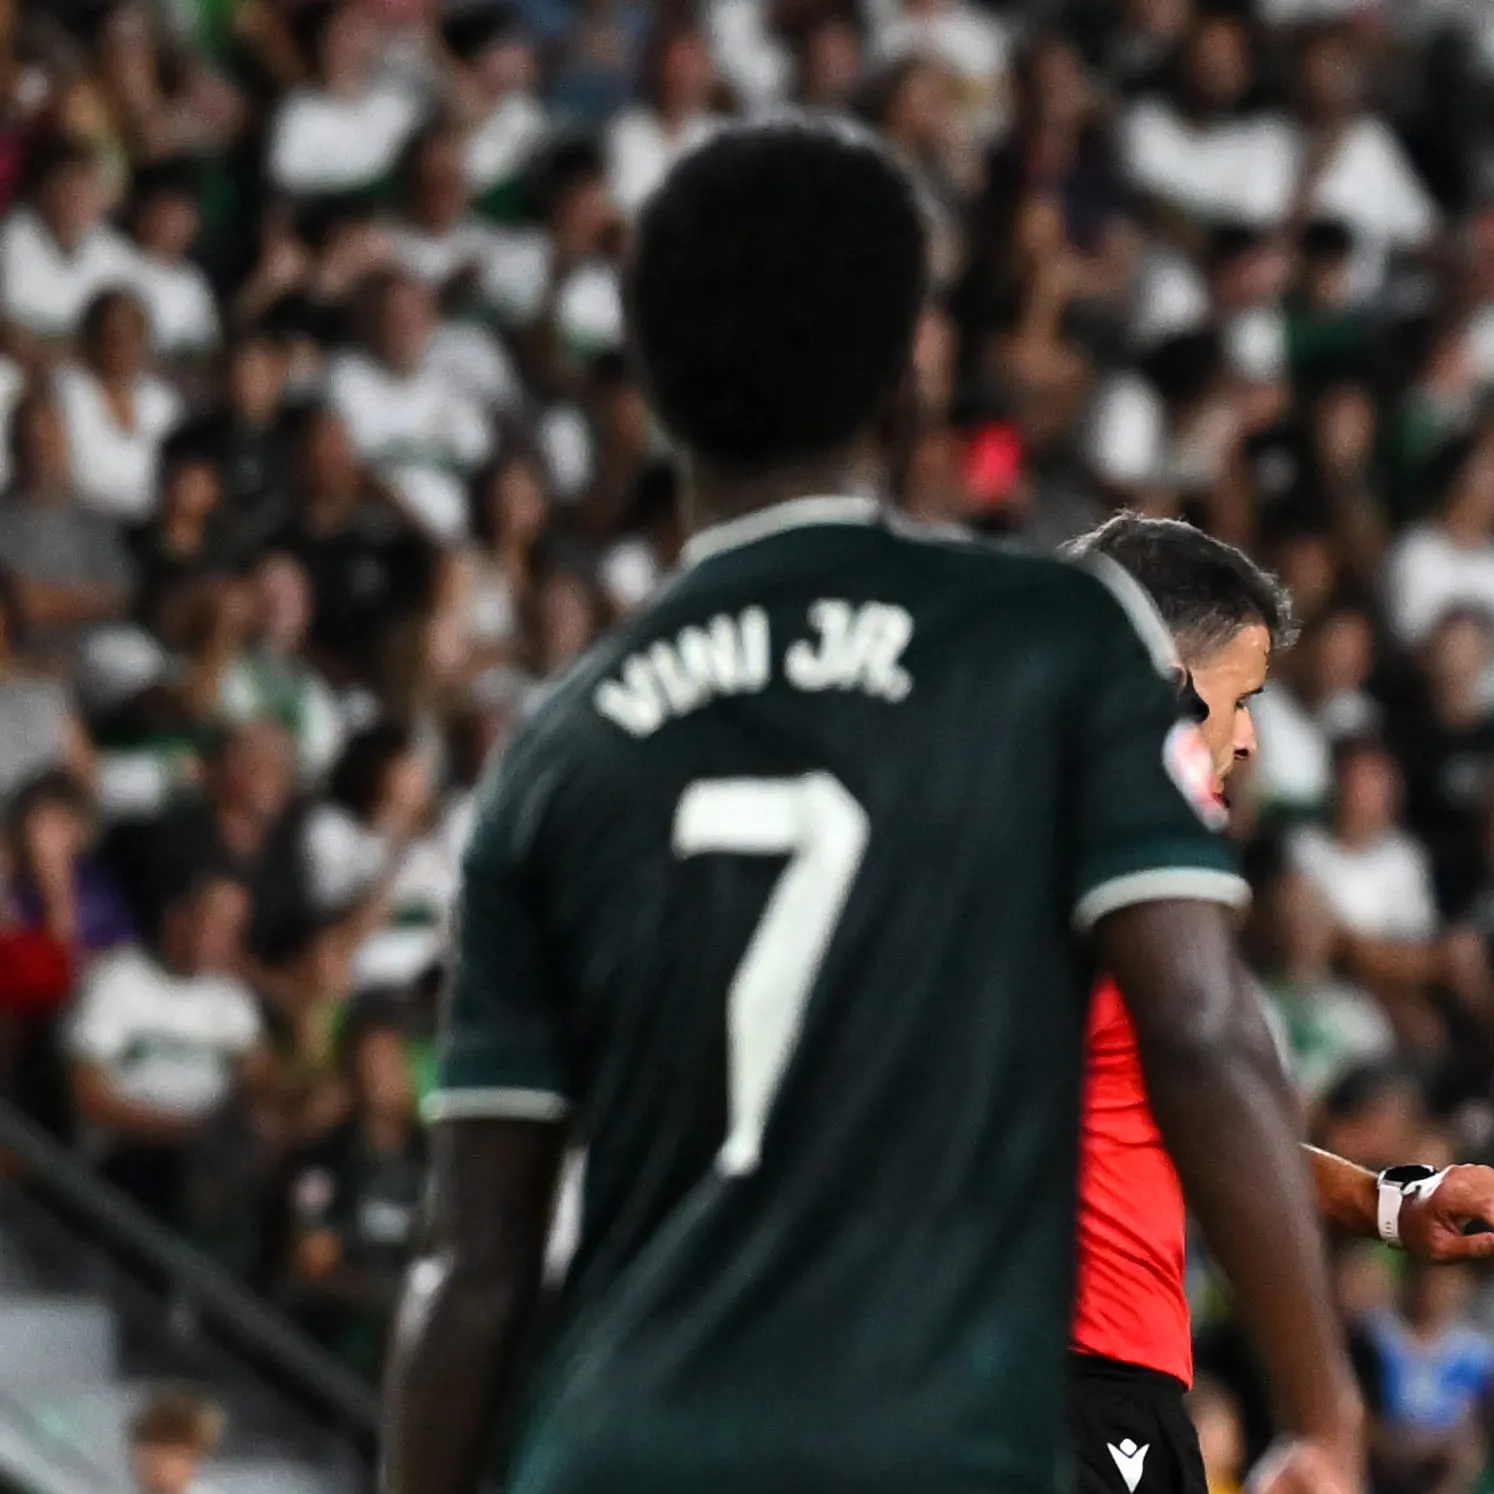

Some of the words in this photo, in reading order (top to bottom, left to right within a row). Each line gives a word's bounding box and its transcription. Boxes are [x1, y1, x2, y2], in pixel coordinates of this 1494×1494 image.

[594, 605, 771, 738] VINI
[785, 600, 914, 702] JR.
[671, 770, 871, 1177] 7
